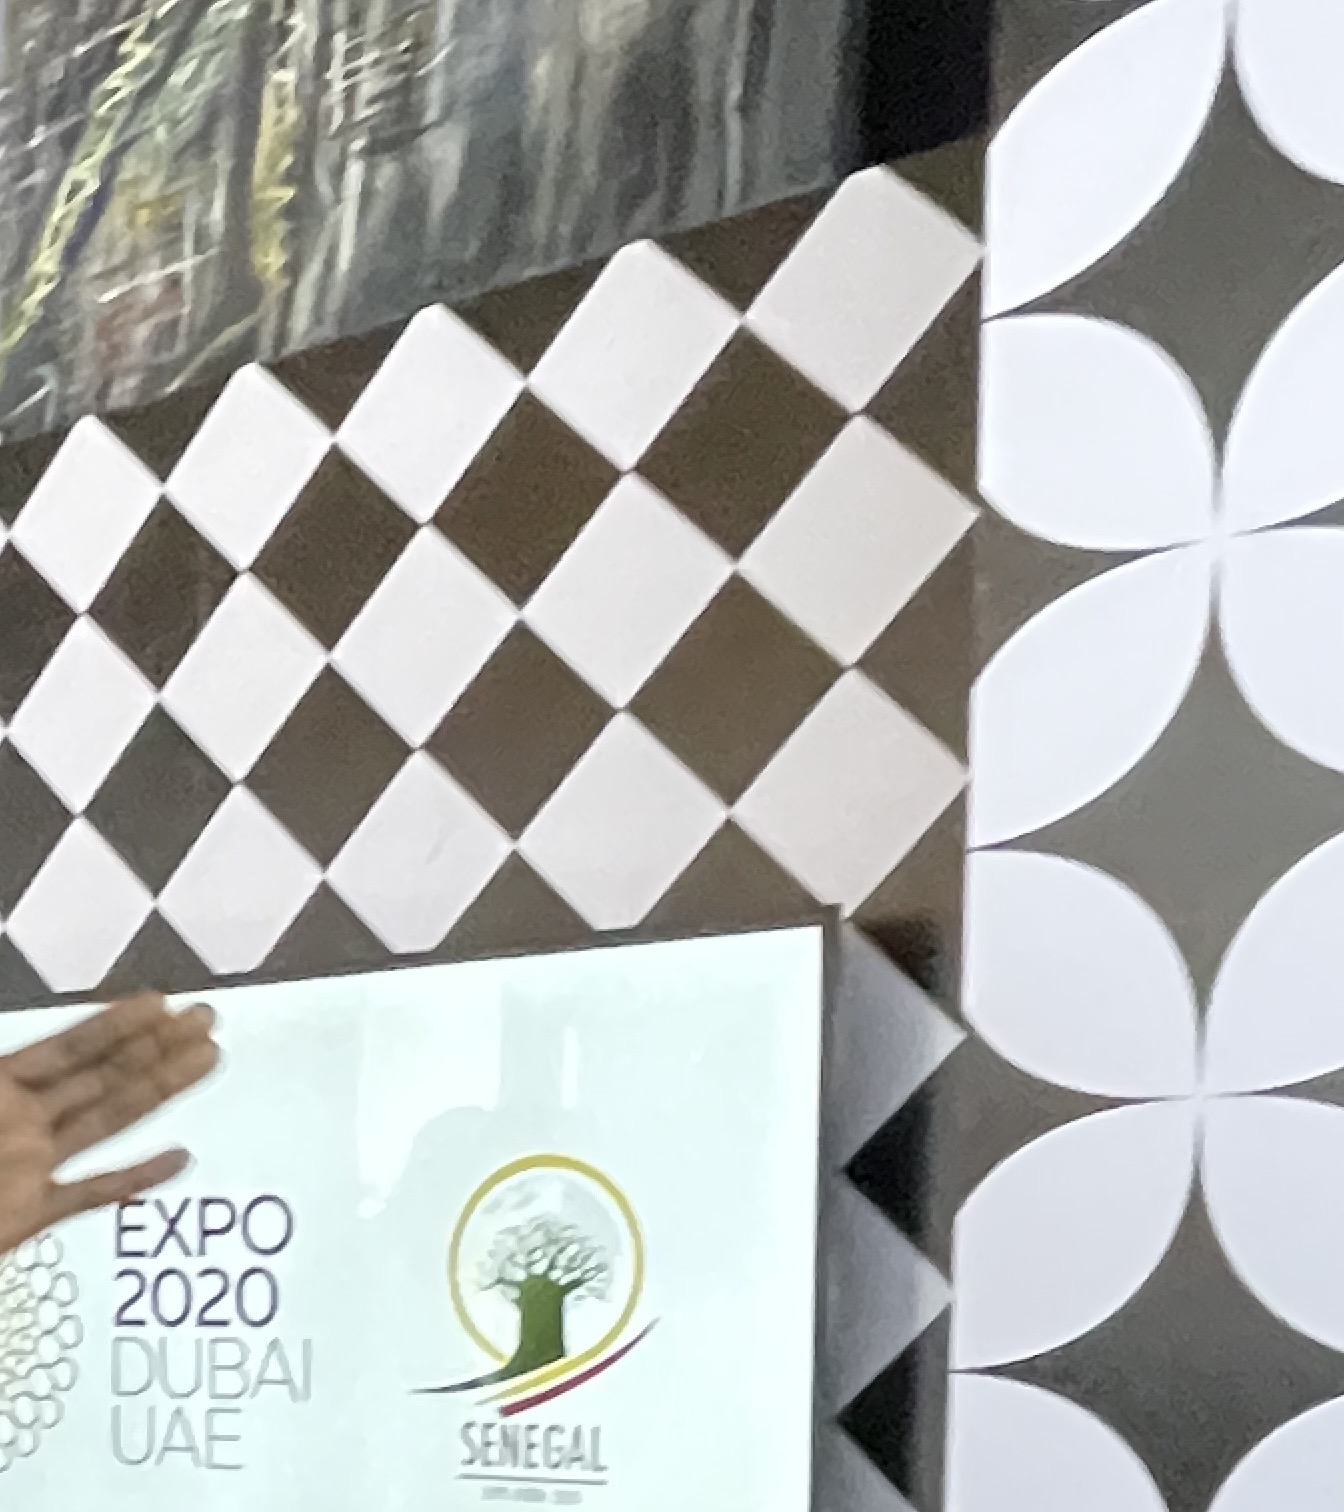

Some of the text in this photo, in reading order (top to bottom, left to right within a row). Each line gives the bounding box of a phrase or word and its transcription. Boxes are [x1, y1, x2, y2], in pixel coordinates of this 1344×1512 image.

[115, 1194, 295, 1259] EXPO
[113, 1266, 281, 1328] 2020
[111, 1335, 313, 1403] DUBAI
[111, 1404, 246, 1471] UAE
[459, 1420, 610, 1473] SENEGAL
